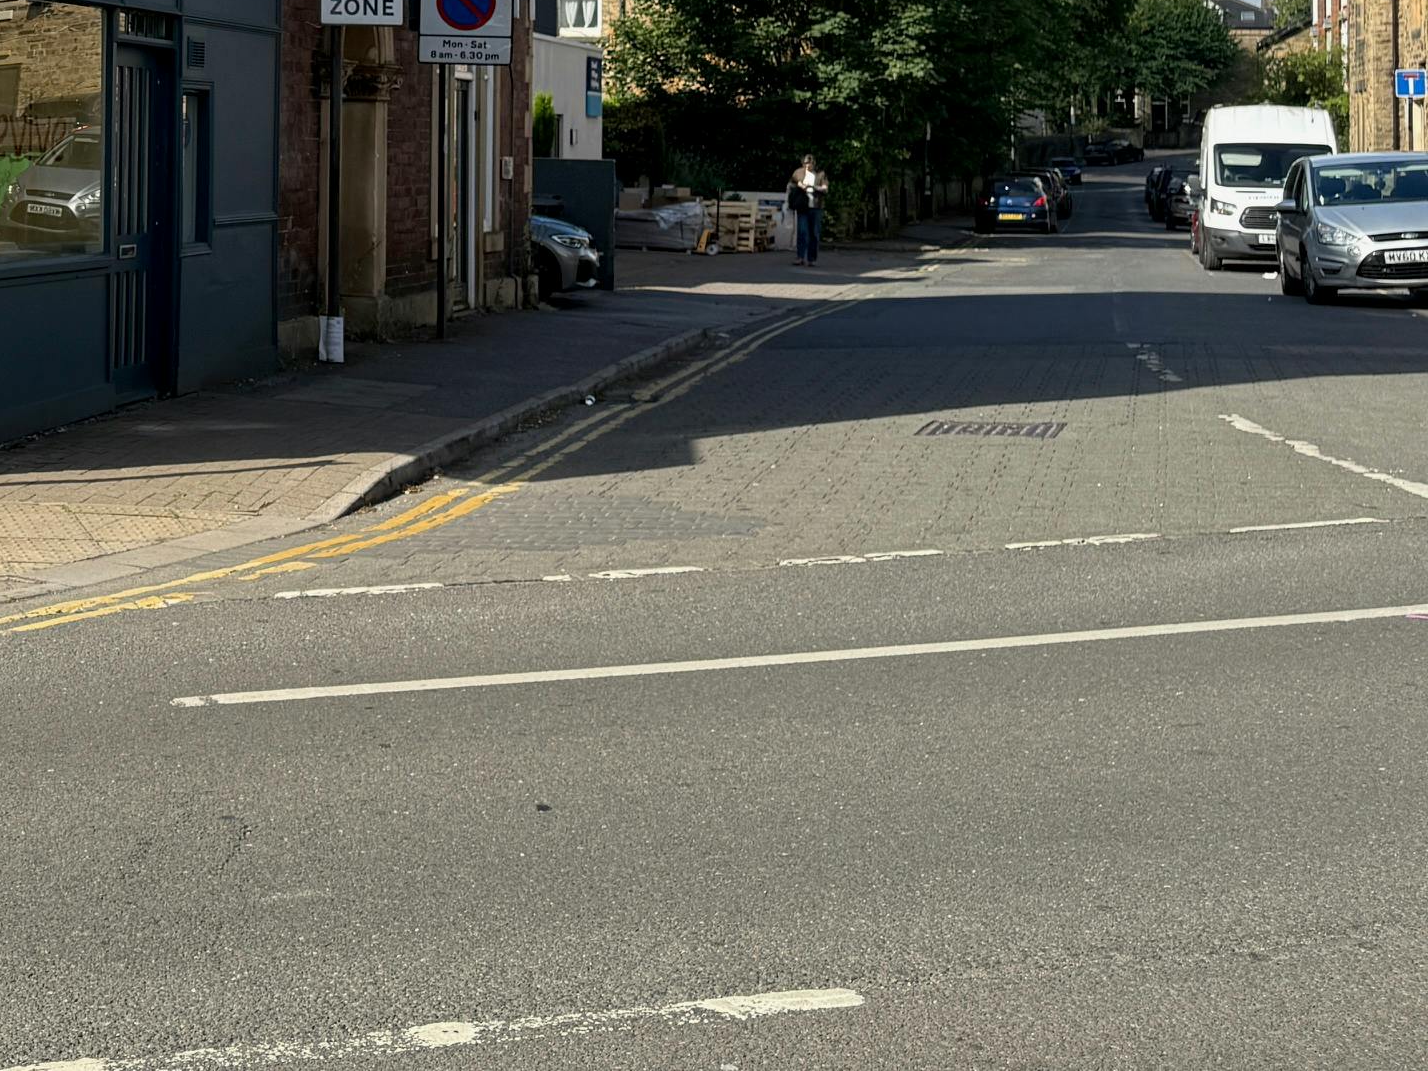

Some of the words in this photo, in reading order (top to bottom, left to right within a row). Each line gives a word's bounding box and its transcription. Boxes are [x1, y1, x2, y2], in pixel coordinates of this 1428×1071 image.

[442, 39, 463, 49] Mon
[470, 40, 487, 49] Sat
[430, 50, 437, 59] 8
[438, 51, 453, 59] am
[460, 50, 483, 60] 6.30
[484, 52, 500, 61] pm
